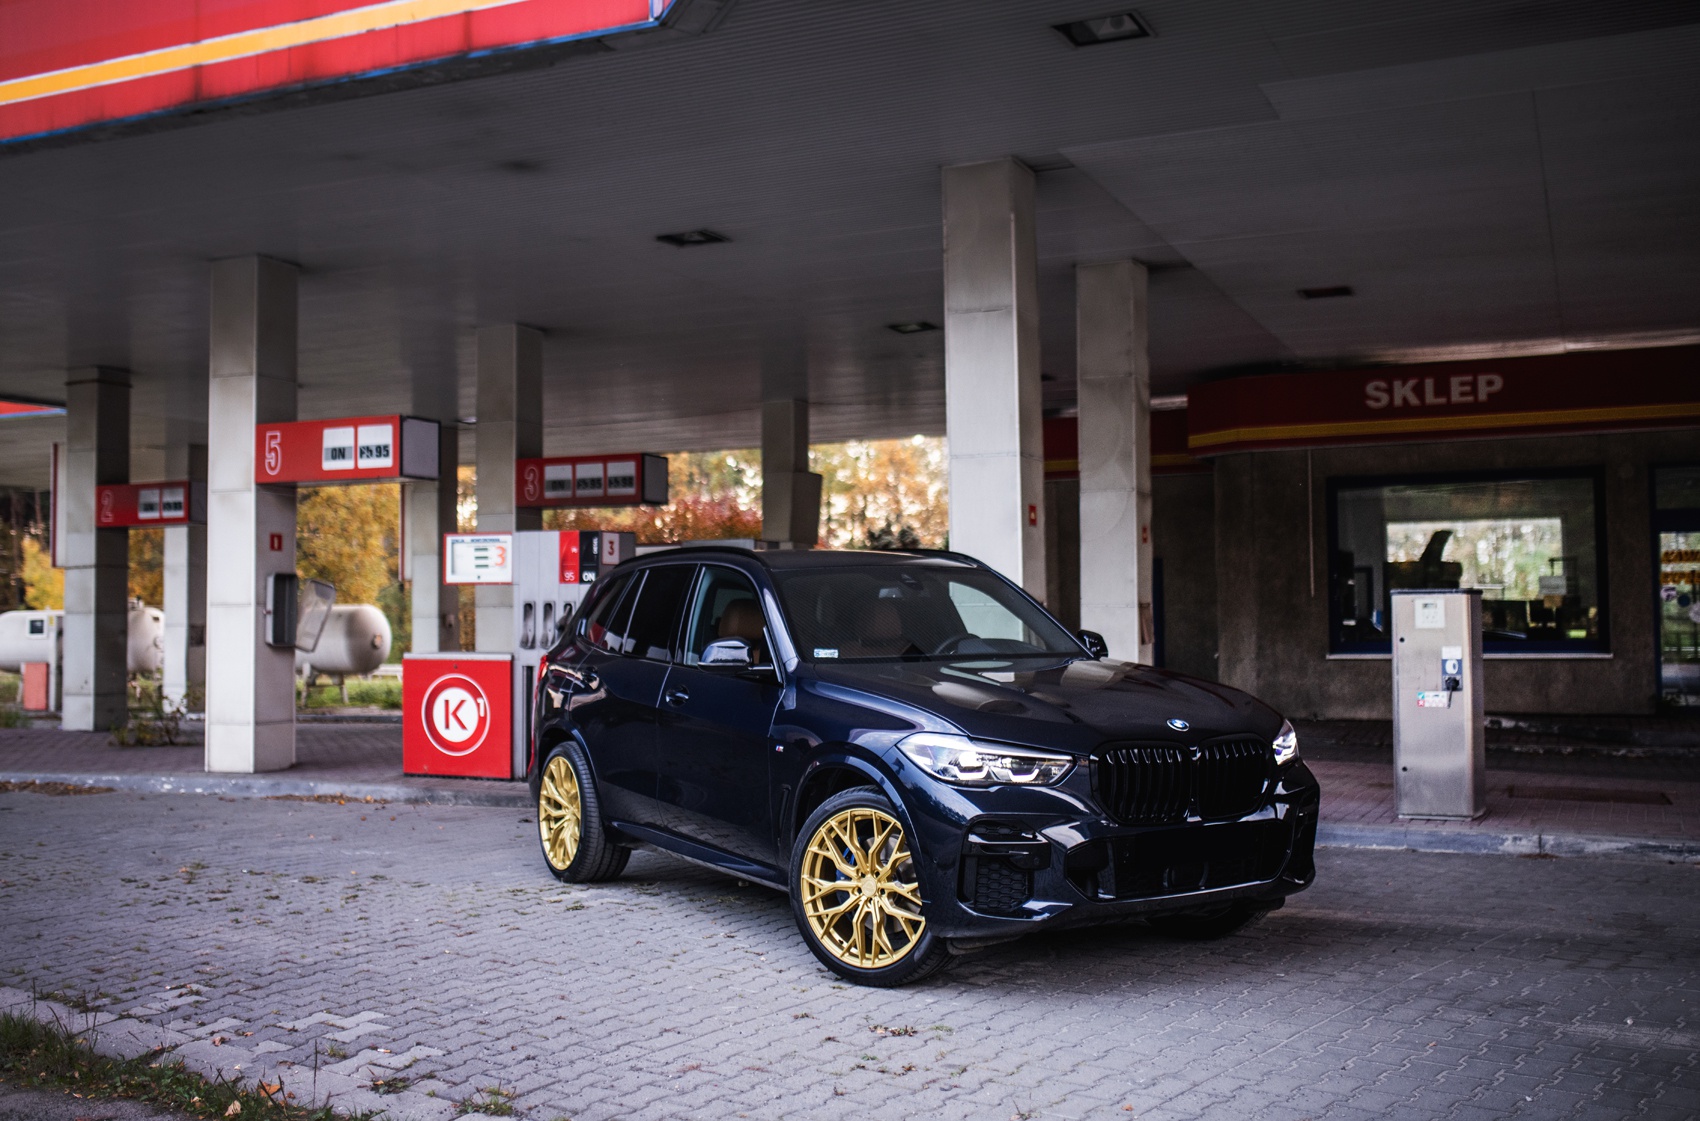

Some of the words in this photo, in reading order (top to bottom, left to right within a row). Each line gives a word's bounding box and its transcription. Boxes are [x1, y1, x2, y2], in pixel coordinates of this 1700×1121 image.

[1365, 374, 1504, 409] SKLEP
[265, 430, 282, 476] 5
[330, 447, 346, 461] ON
[375, 444, 390, 458] 95
[524, 466, 540, 501] 3
[101, 489, 114, 523] 2
[495, 545, 507, 567] 3
[608, 540, 615, 556] 3
[564, 571, 575, 581] 95
[582, 571, 596, 582] ON
[444, 699, 468, 731] K
